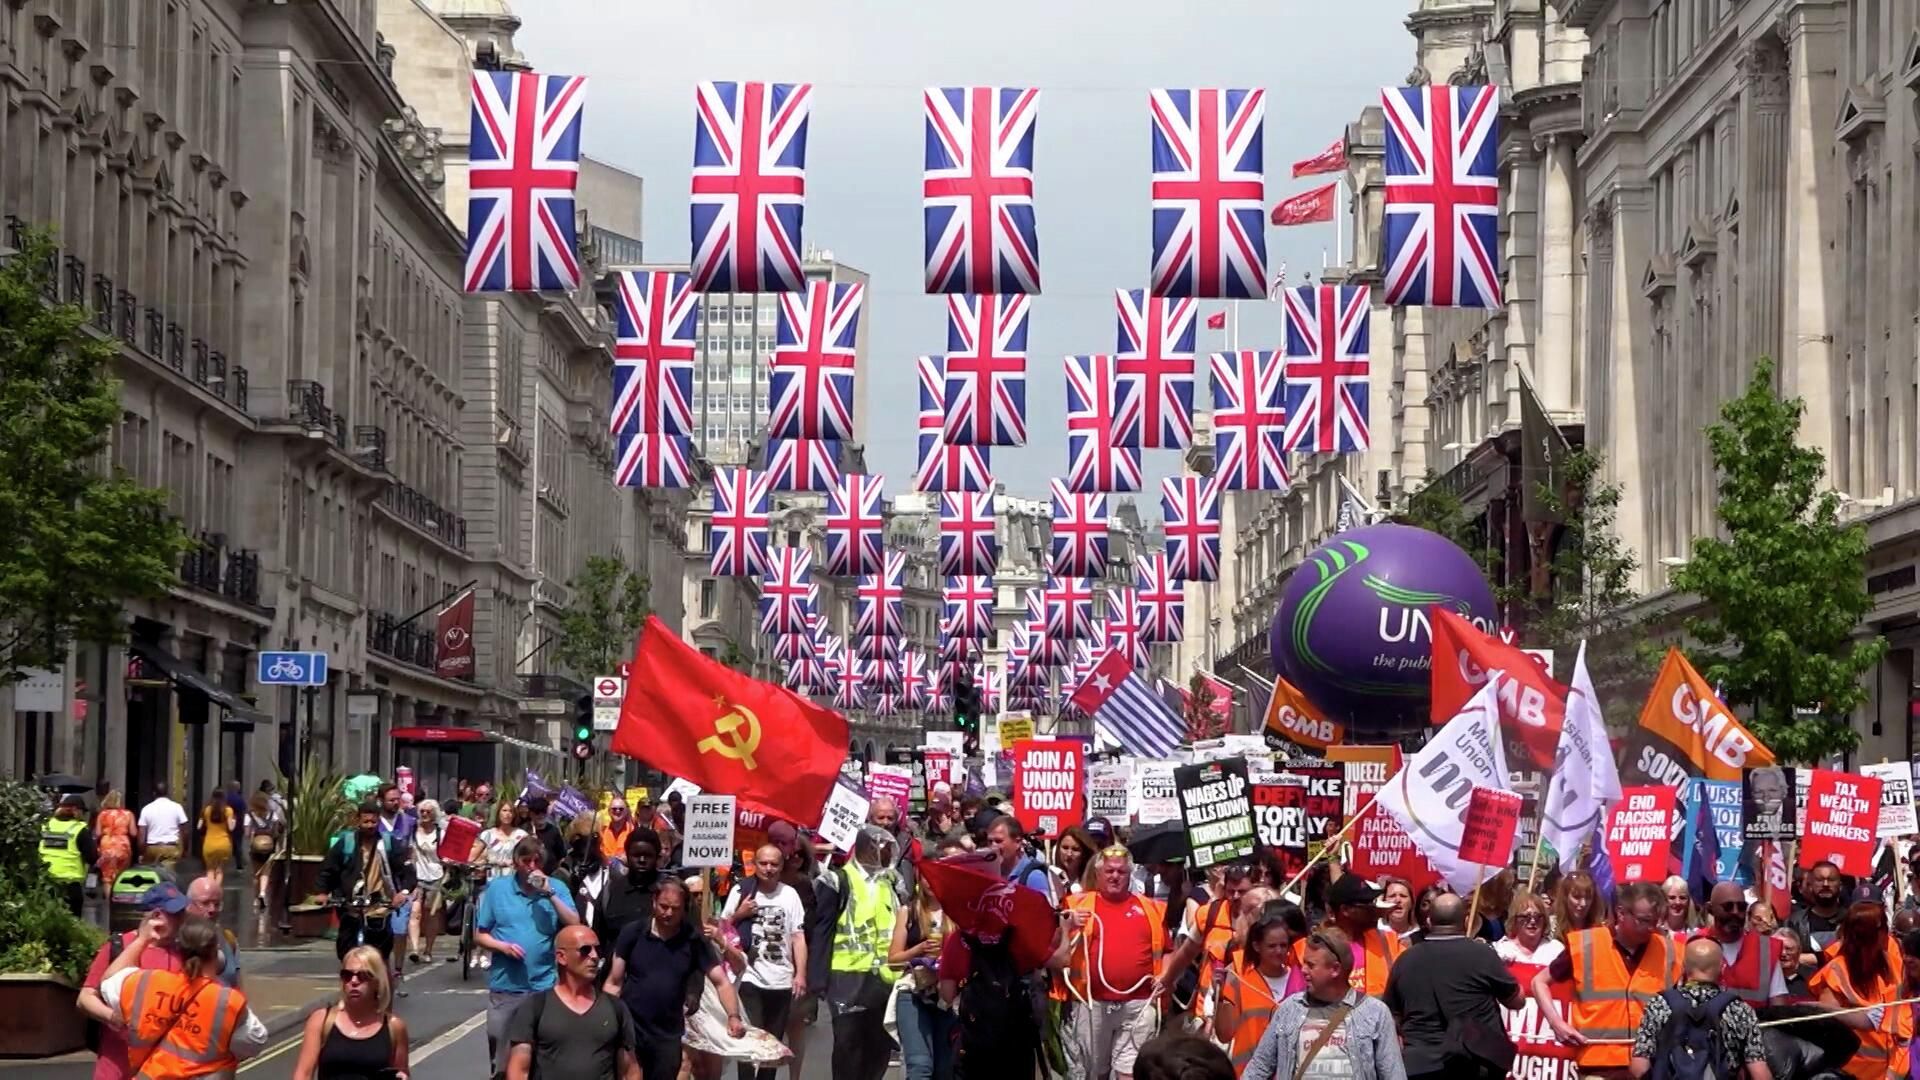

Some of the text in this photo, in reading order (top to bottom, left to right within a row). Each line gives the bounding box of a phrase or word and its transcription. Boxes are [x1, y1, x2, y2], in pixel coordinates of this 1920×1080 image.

[1373, 653, 1396, 667] the
[1278, 705, 1335, 742] GMB
[1672, 683, 1754, 768] GMB
[1022, 751, 1076, 770] JOIN A
[1455, 733, 1492, 778] Union
[1022, 771, 1075, 790] UNION
[1344, 761, 1388, 787] QUEEZE
[1182, 776, 1245, 808] WAGES UP
[1834, 781, 1859, 798] TAX
[1882, 791, 1908, 806] UT!
[692, 803, 730, 814] FREE
[1022, 791, 1075, 810] TODAY
[1629, 795, 1656, 811] END
[1820, 794, 1869, 814] WEALTH
[740, 810, 766, 829] OUT
[1185, 803, 1217, 826] BILLS
[1216, 797, 1250, 819] DOWN
[1253, 806, 1305, 827] TORY
[1615, 810, 1667, 826] RACISM
[1829, 809, 1856, 825] NOT
[1190, 816, 1251, 846] TORIES OUT
[1363, 817, 1404, 834] RACIS
[1609, 826, 1667, 842] AT WORK
[1811, 821, 1871, 842] WORKERS
[1257, 824, 1306, 847] RULE
[1358, 835, 1374, 849] AT
[688, 847, 728, 858] NOW!
[1369, 851, 1402, 866] NOW
[1620, 842, 1653, 857] NOW
[156, 991, 201, 1018] TUC
